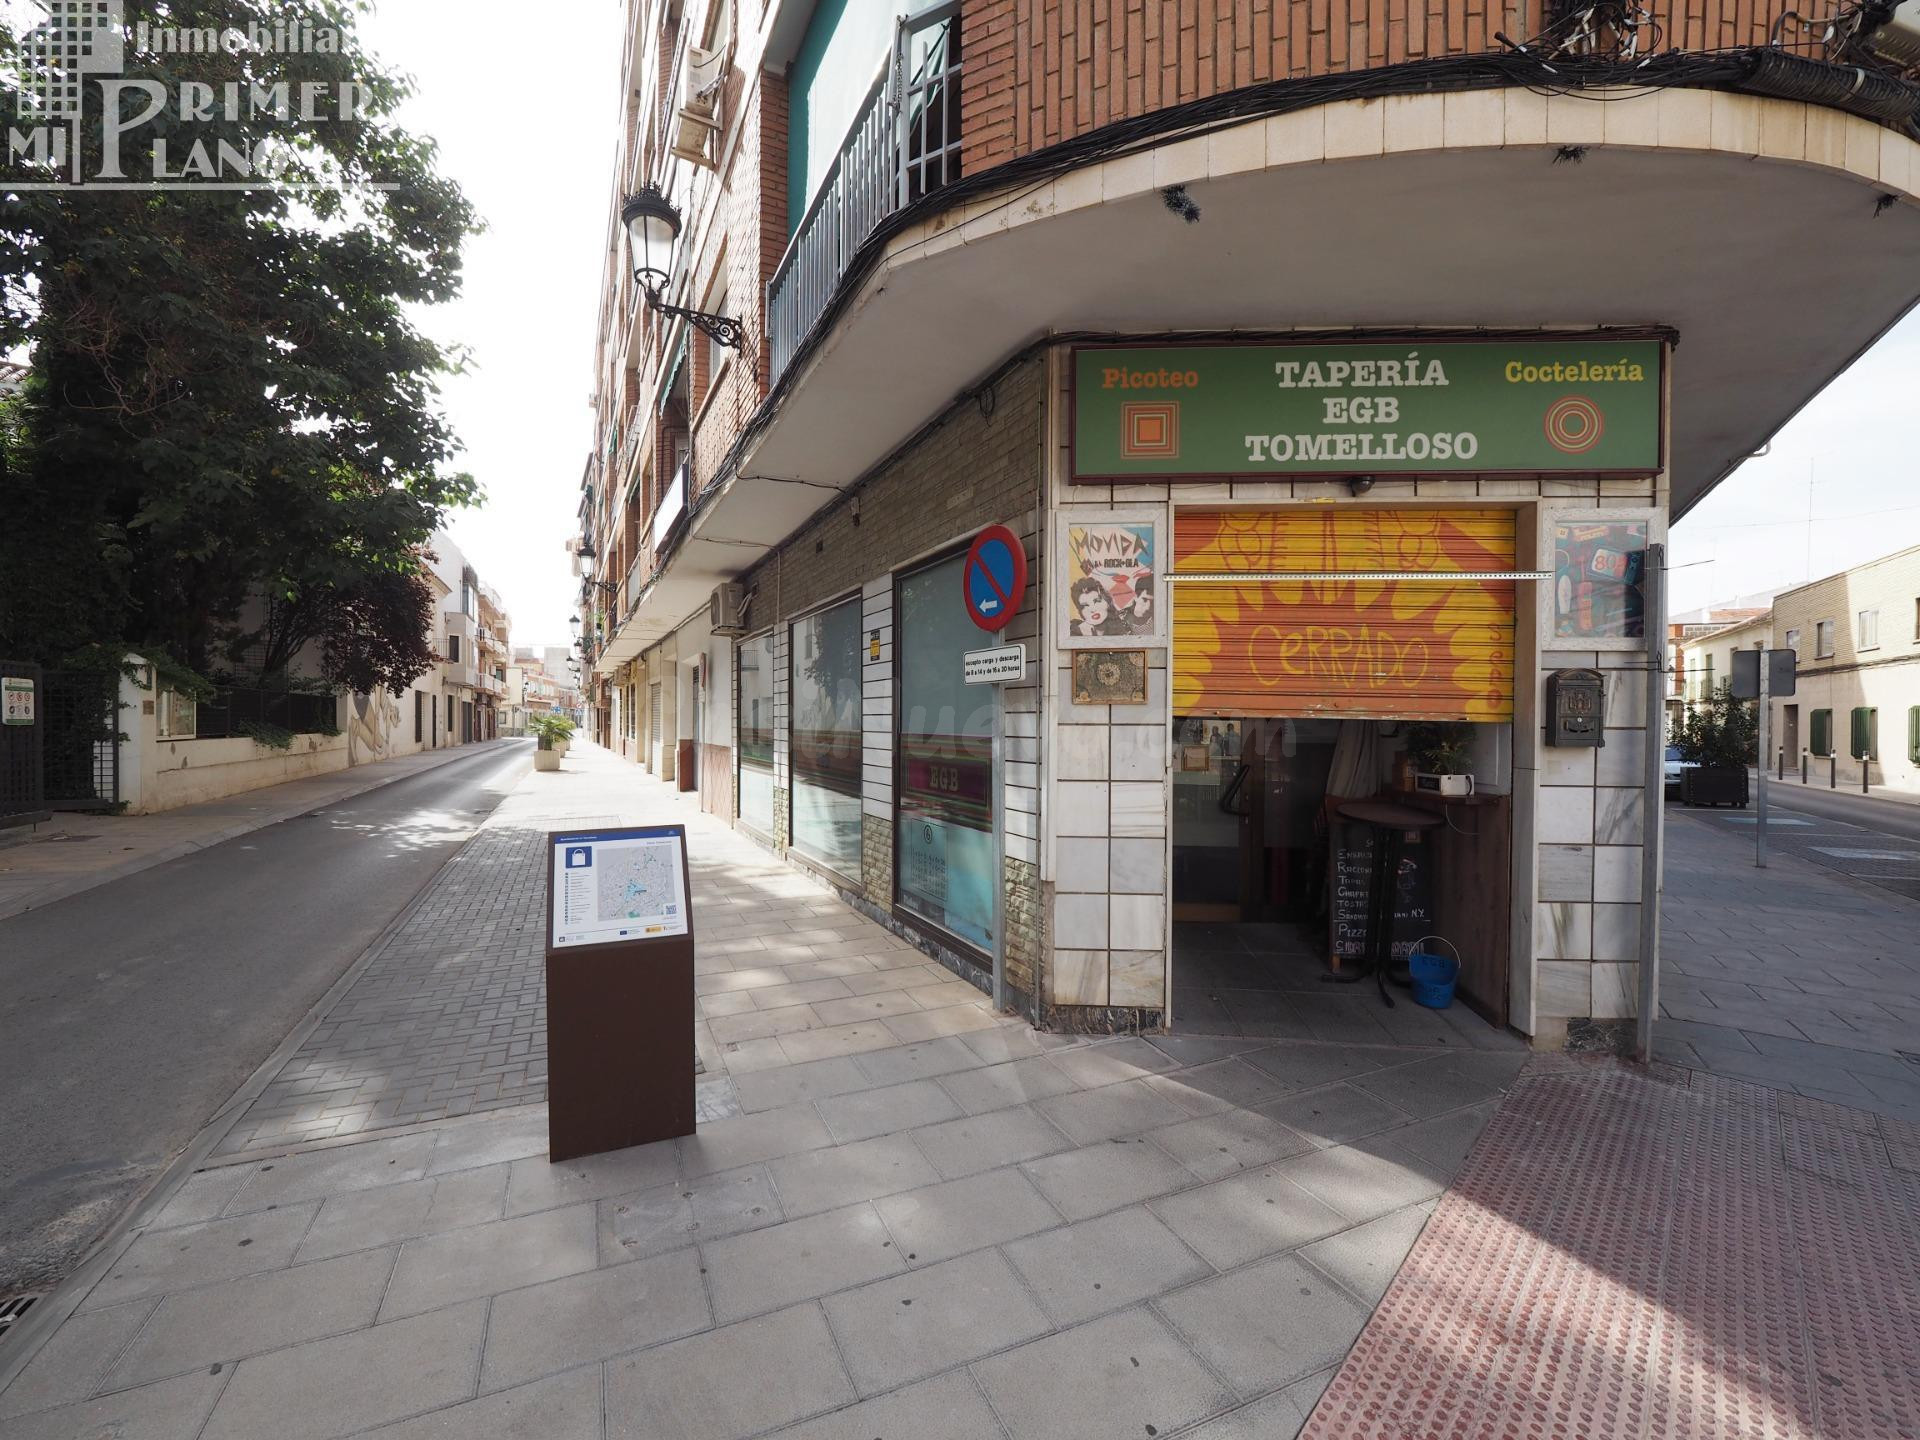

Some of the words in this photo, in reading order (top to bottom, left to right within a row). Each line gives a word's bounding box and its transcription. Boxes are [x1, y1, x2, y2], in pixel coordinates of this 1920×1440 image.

[1101, 367, 1200, 390] Picoteo
[1275, 352, 1450, 389] TAPERÍA
[1504, 358, 1644, 384] Coctelería
[1322, 397, 1400, 425] EGB
[1244, 432, 1479, 462] TOMELLOSO
[1074, 531, 1150, 557] MOVIDA
[999, 654, 1019, 662] descarga
[929, 767, 960, 792] EGB
